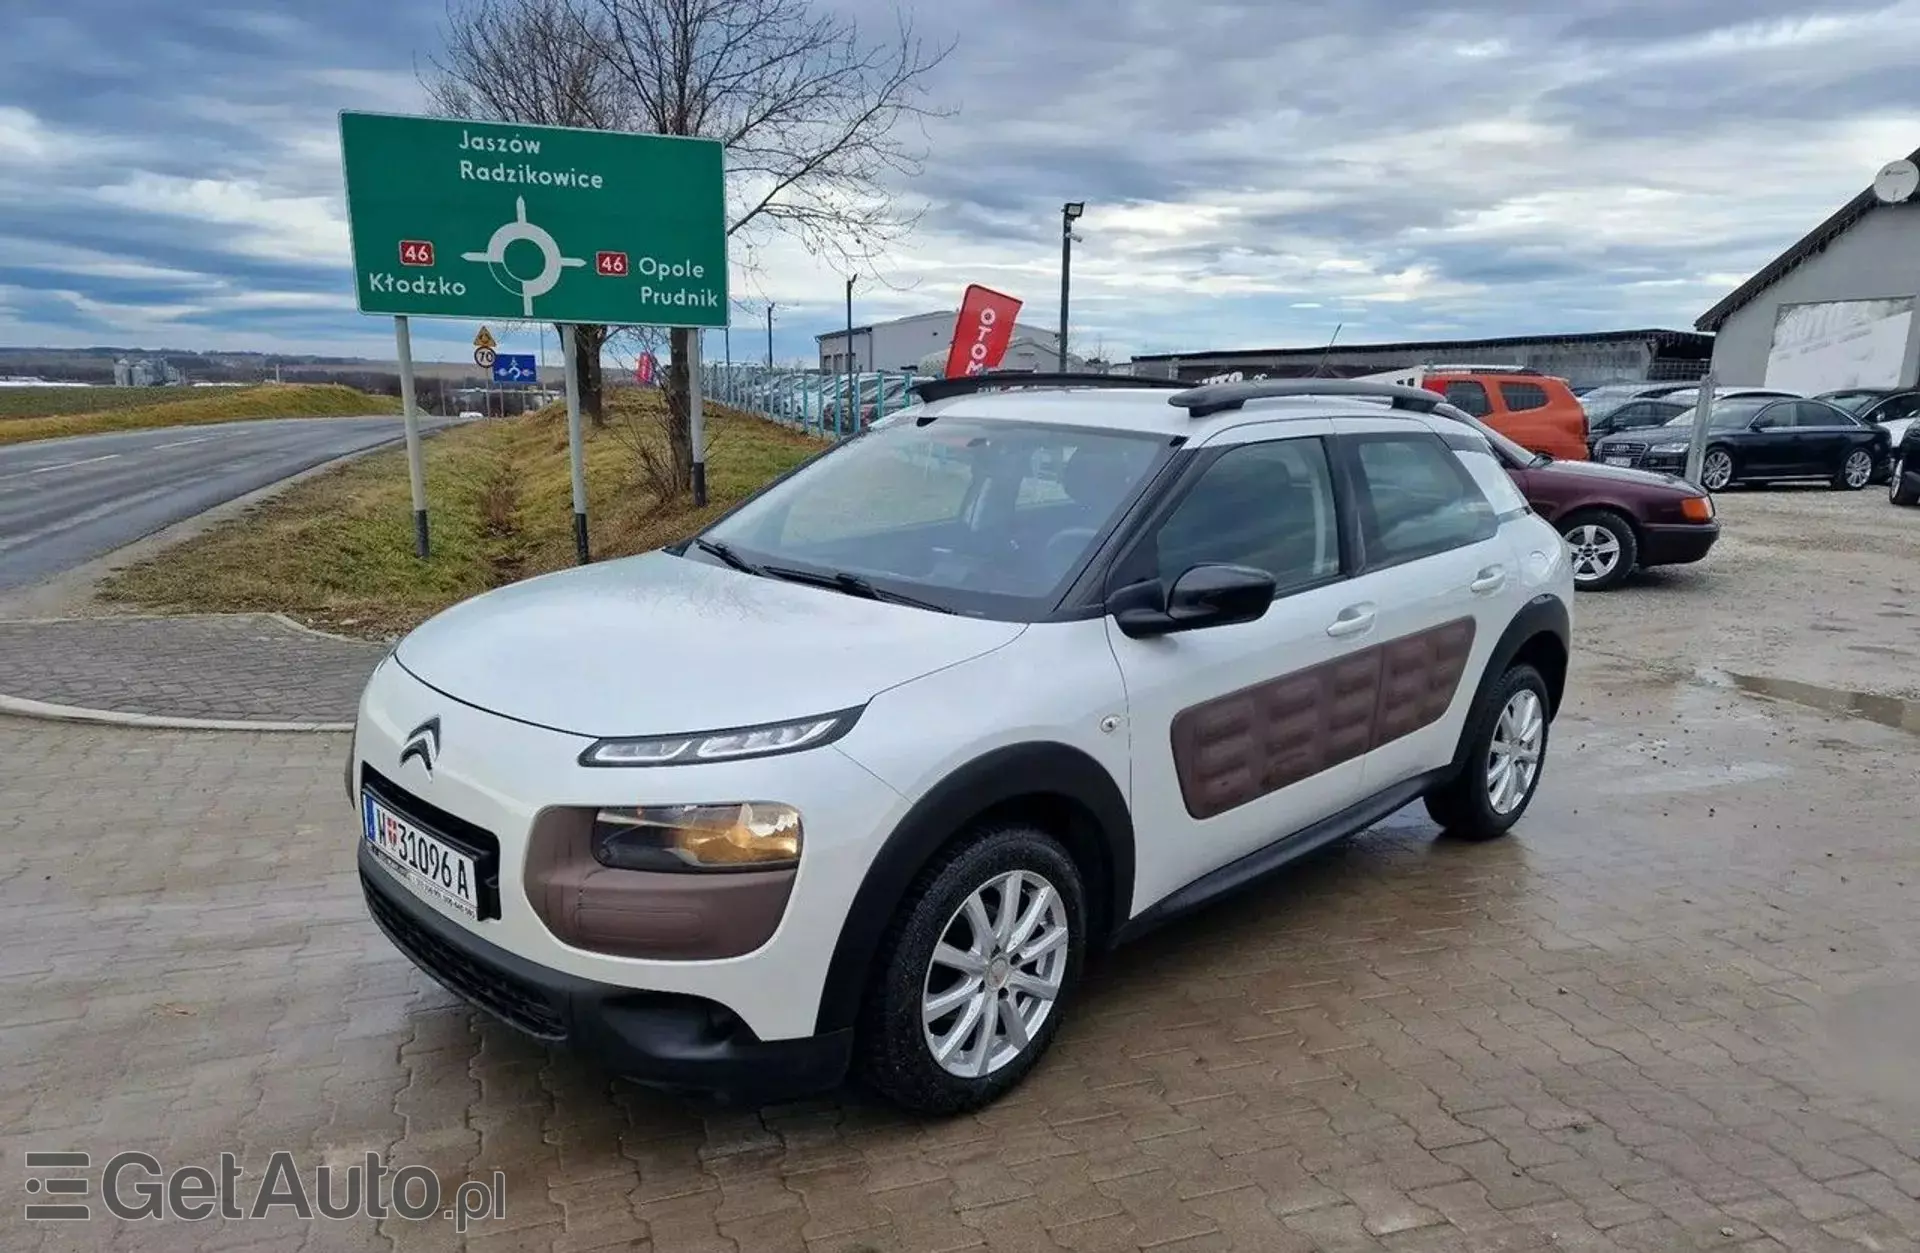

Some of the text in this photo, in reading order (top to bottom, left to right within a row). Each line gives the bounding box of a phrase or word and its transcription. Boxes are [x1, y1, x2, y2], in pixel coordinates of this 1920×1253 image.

[458, 129, 541, 156] Jaszów
[459, 160, 604, 189] Radzikowice
[404, 244, 429, 262] 46
[601, 255, 624, 273] 46
[638, 257, 705, 280] Opole
[368, 273, 467, 297] Kłodzko
[640, 287, 718, 308] Prudnik
[477, 351, 494, 363] 70
